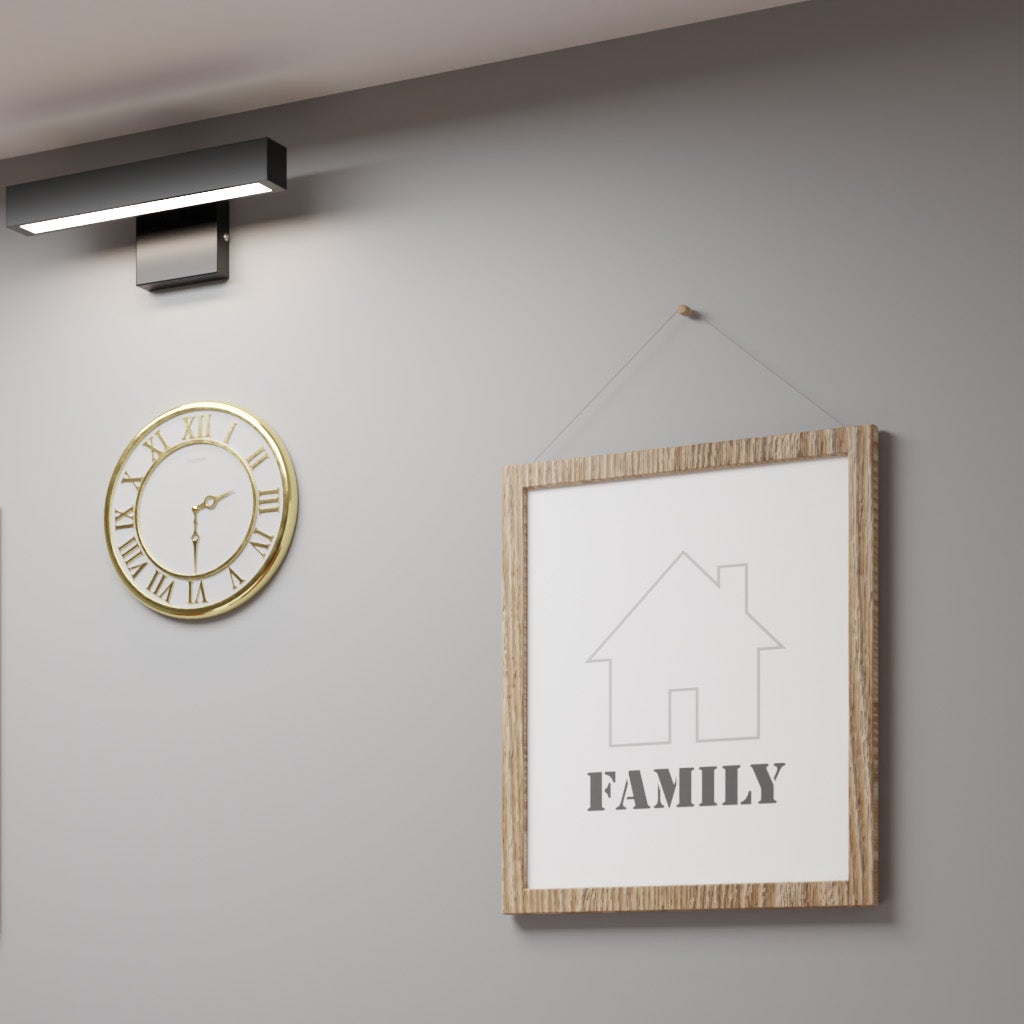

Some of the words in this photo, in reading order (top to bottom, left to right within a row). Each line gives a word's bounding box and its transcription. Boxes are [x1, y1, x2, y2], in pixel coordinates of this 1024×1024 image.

[182, 414, 212, 440] XII
[224, 421, 237, 443] I
[143, 430, 171, 462] XI
[247, 447, 270, 470] II
[121, 471, 144, 490] X
[258, 487, 280, 515] III
[114, 506, 134, 531] IX
[249, 528, 274, 558] IV
[118, 536, 148, 579] VIII
[146, 570, 175, 604] VII
[228, 566, 246, 590] V
[187, 580, 208, 604] VI
[587, 762, 786, 812] FAMILY
